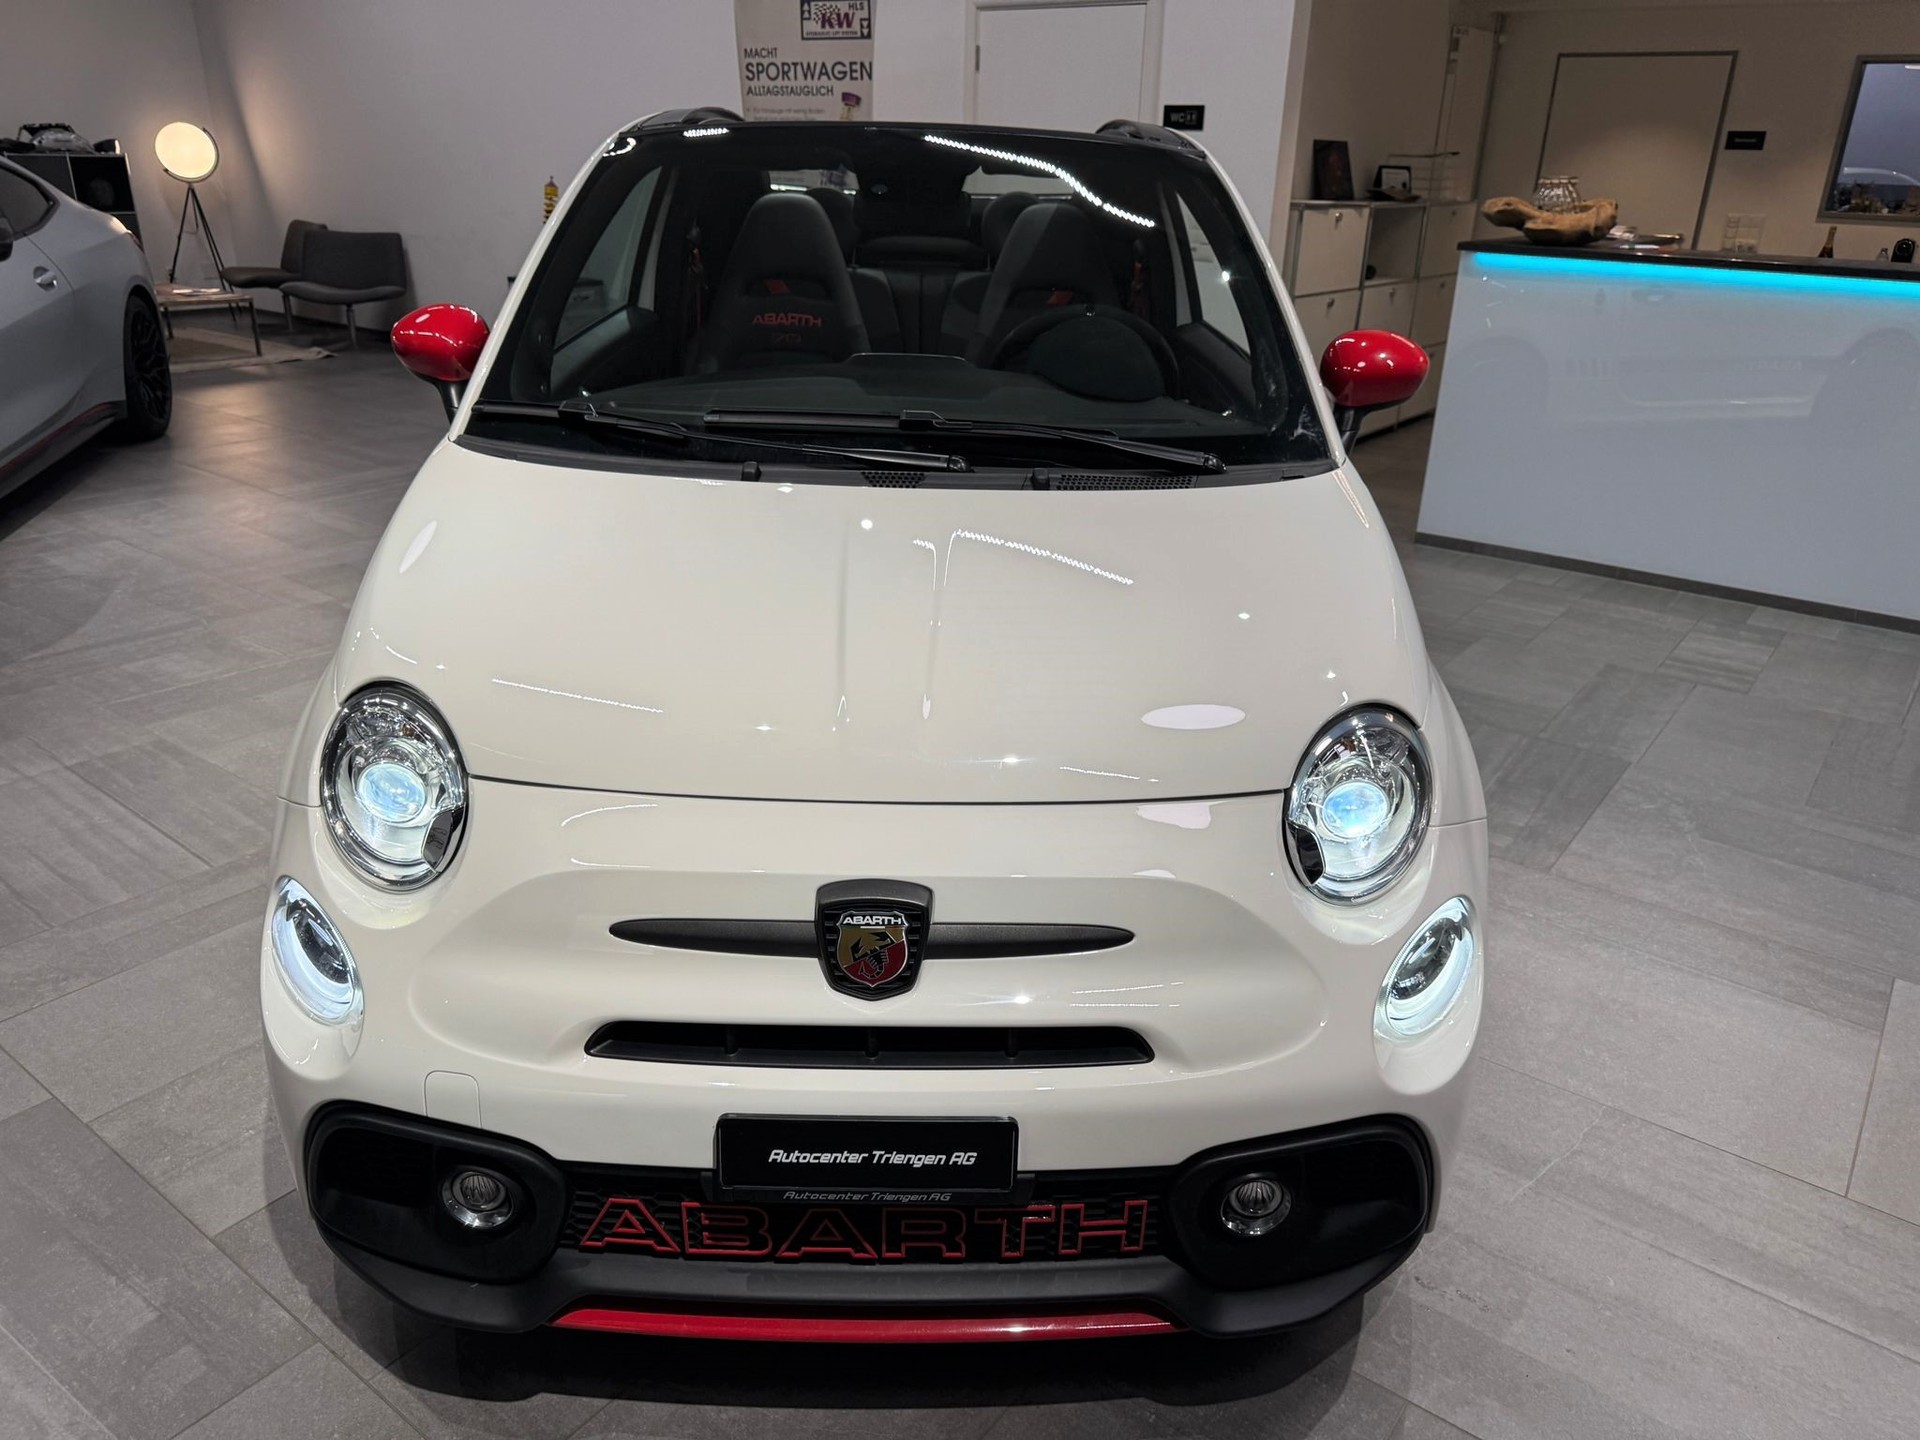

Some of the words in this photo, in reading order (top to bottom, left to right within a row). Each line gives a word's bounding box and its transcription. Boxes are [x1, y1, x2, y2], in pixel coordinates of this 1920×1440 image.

[848, 2, 865, 11] HLS
[821, 12, 855, 29] KW
[744, 48, 778, 59] MACHT
[745, 61, 873, 82] SPORTWAGEN
[746, 85, 834, 97] ALLTAGSTAUGLICH
[1170, 112, 1185, 123] WC
[752, 312, 822, 327] ABARTH
[842, 915, 902, 925] ABARTH
[769, 1149, 869, 1164] Autocenter
[949, 1152, 977, 1165] AG
[784, 1190, 866, 1202] Autocenter
[929, 1192, 952, 1202] AG
[579, 1197, 1149, 1259] ABARTH
